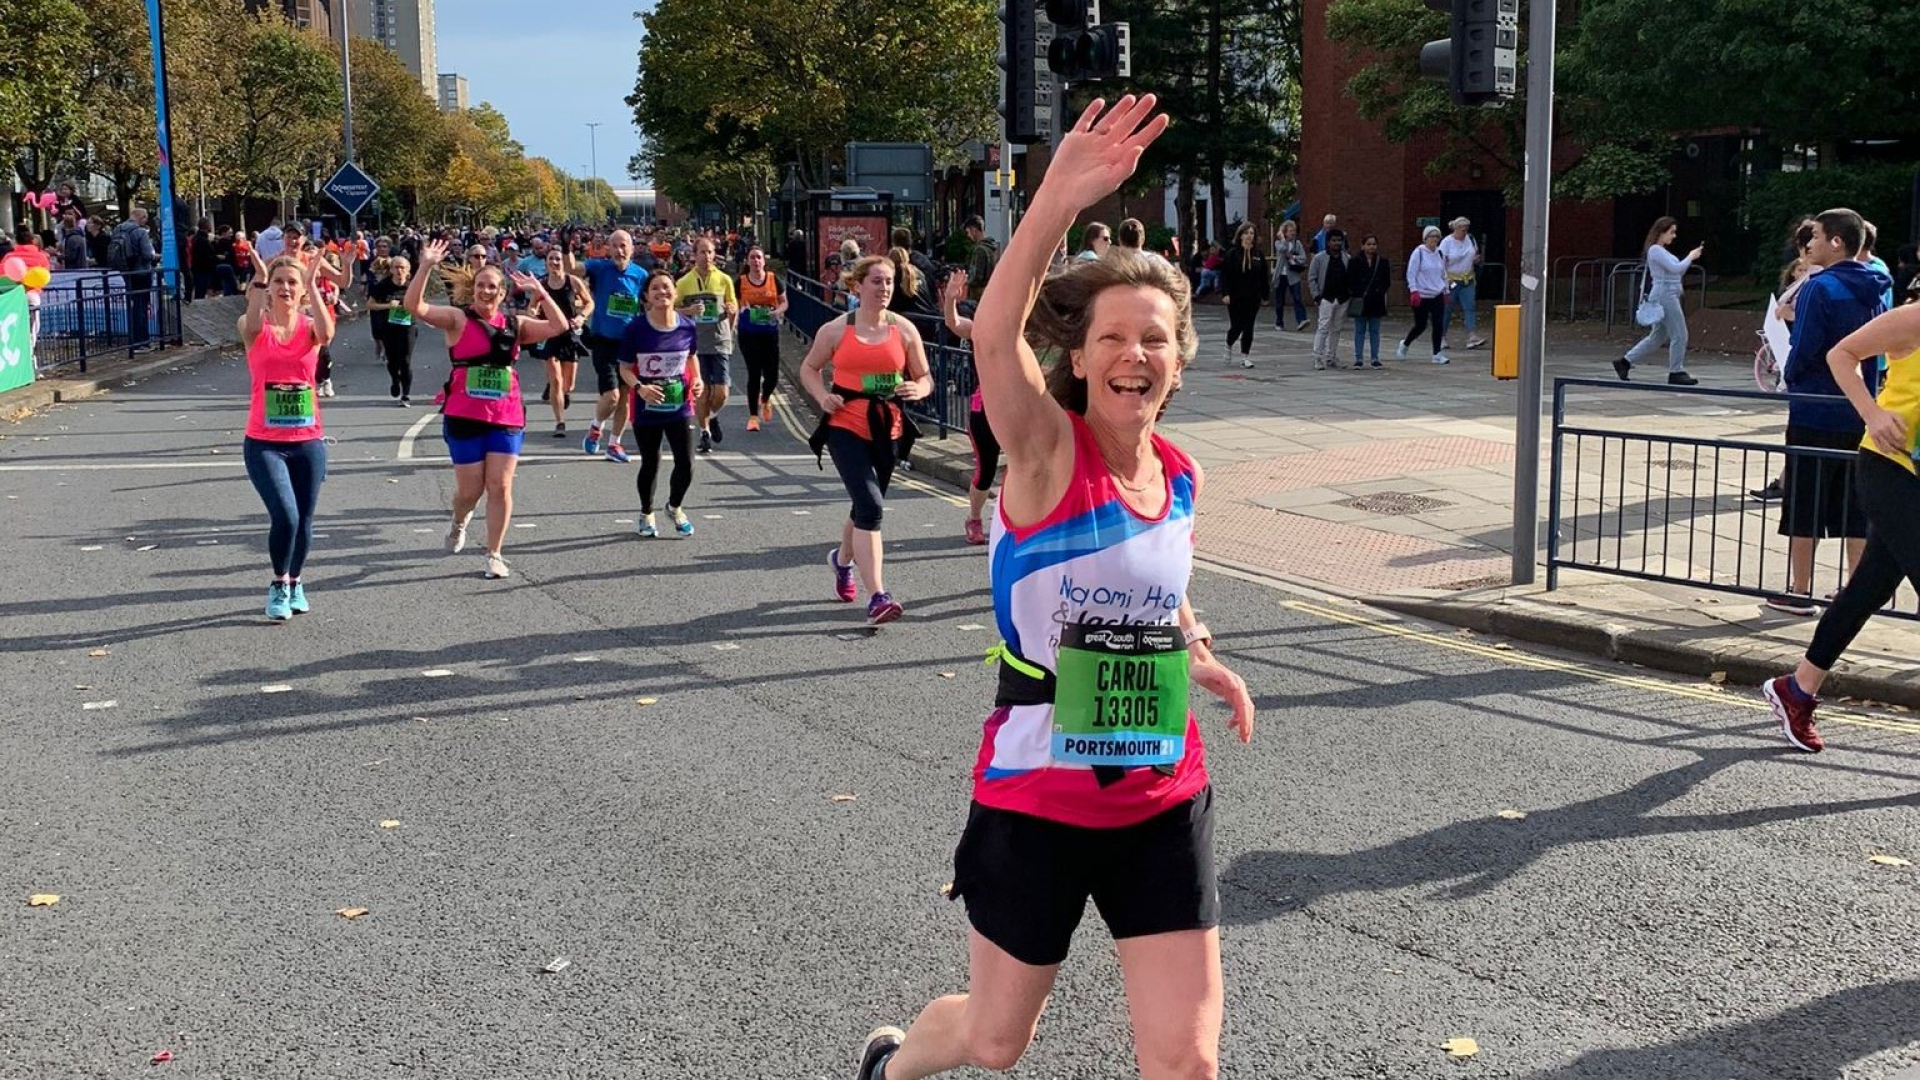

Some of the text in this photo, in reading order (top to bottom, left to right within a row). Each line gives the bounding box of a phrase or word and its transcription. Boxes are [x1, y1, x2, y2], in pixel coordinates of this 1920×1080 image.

[1060, 575, 1134, 608] Naomi
[1085, 633, 1106, 644] great
[1113, 632, 1135, 643] south
[1097, 660, 1159, 691] CAROL
[1092, 696, 1160, 727] 13305
